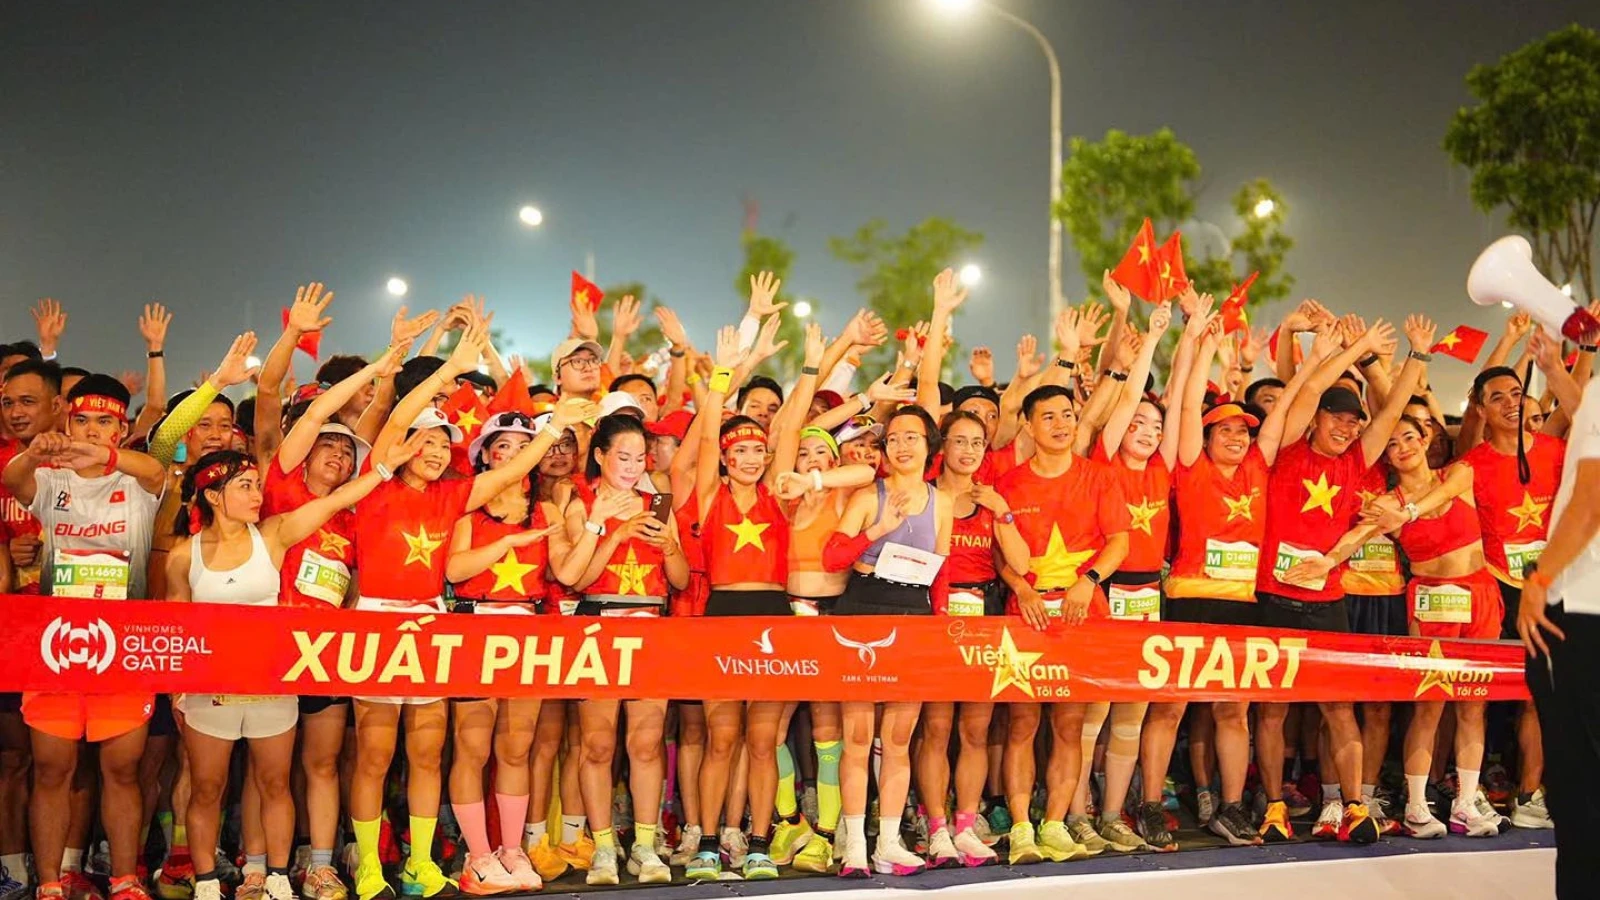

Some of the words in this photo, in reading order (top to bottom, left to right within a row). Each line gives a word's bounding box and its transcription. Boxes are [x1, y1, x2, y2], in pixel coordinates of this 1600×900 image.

[1207, 553, 1221, 566] M
[1276, 556, 1291, 570] M
[1508, 555, 1523, 568] M
[56, 568, 72, 583] M
[79, 567, 123, 578] C14693
[304, 565, 314, 579] F
[1113, 601, 1121, 613] F
[1419, 596, 1426, 608] F
[124, 625, 184, 634] VINHOMES
[123, 635, 213, 654] GLOBAL
[281, 614, 464, 684] XUẤT
[480, 622, 643, 686] PHÁT
[122, 655, 183, 671] GATE
[715, 655, 819, 676] VINHOMES
[959, 644, 1008, 672] Việt
[1014, 662, 1069, 681] Nam
[1138, 635, 1308, 689] START
[1037, 685, 1052, 697] Tôi
